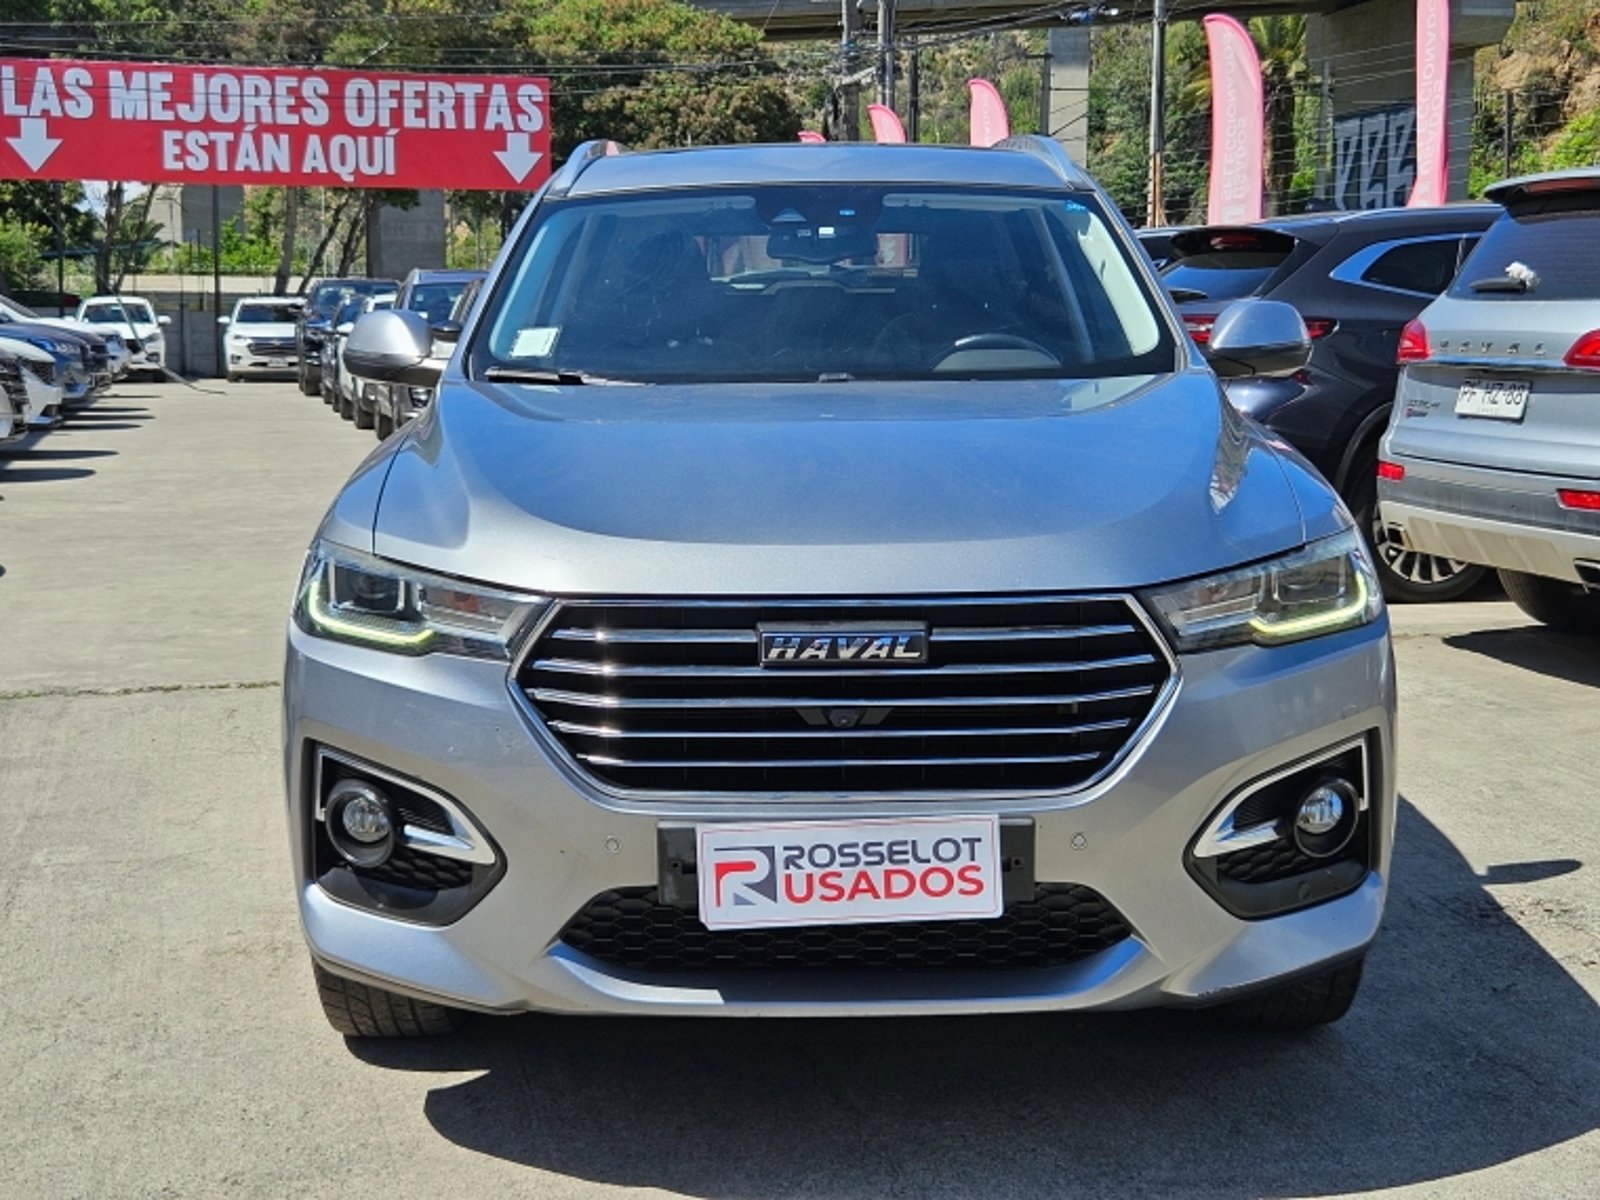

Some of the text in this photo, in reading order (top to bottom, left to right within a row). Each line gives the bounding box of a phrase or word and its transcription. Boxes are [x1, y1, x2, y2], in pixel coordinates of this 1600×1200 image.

[1, 66, 544, 132] LAS MEJORES OFERTAS
[162, 122, 399, 182] ESTÁN AQUÍ
[767, 636, 921, 659] HAVAL
[782, 837, 982, 871] ROSSELOT
[784, 864, 984, 904] USADOS
